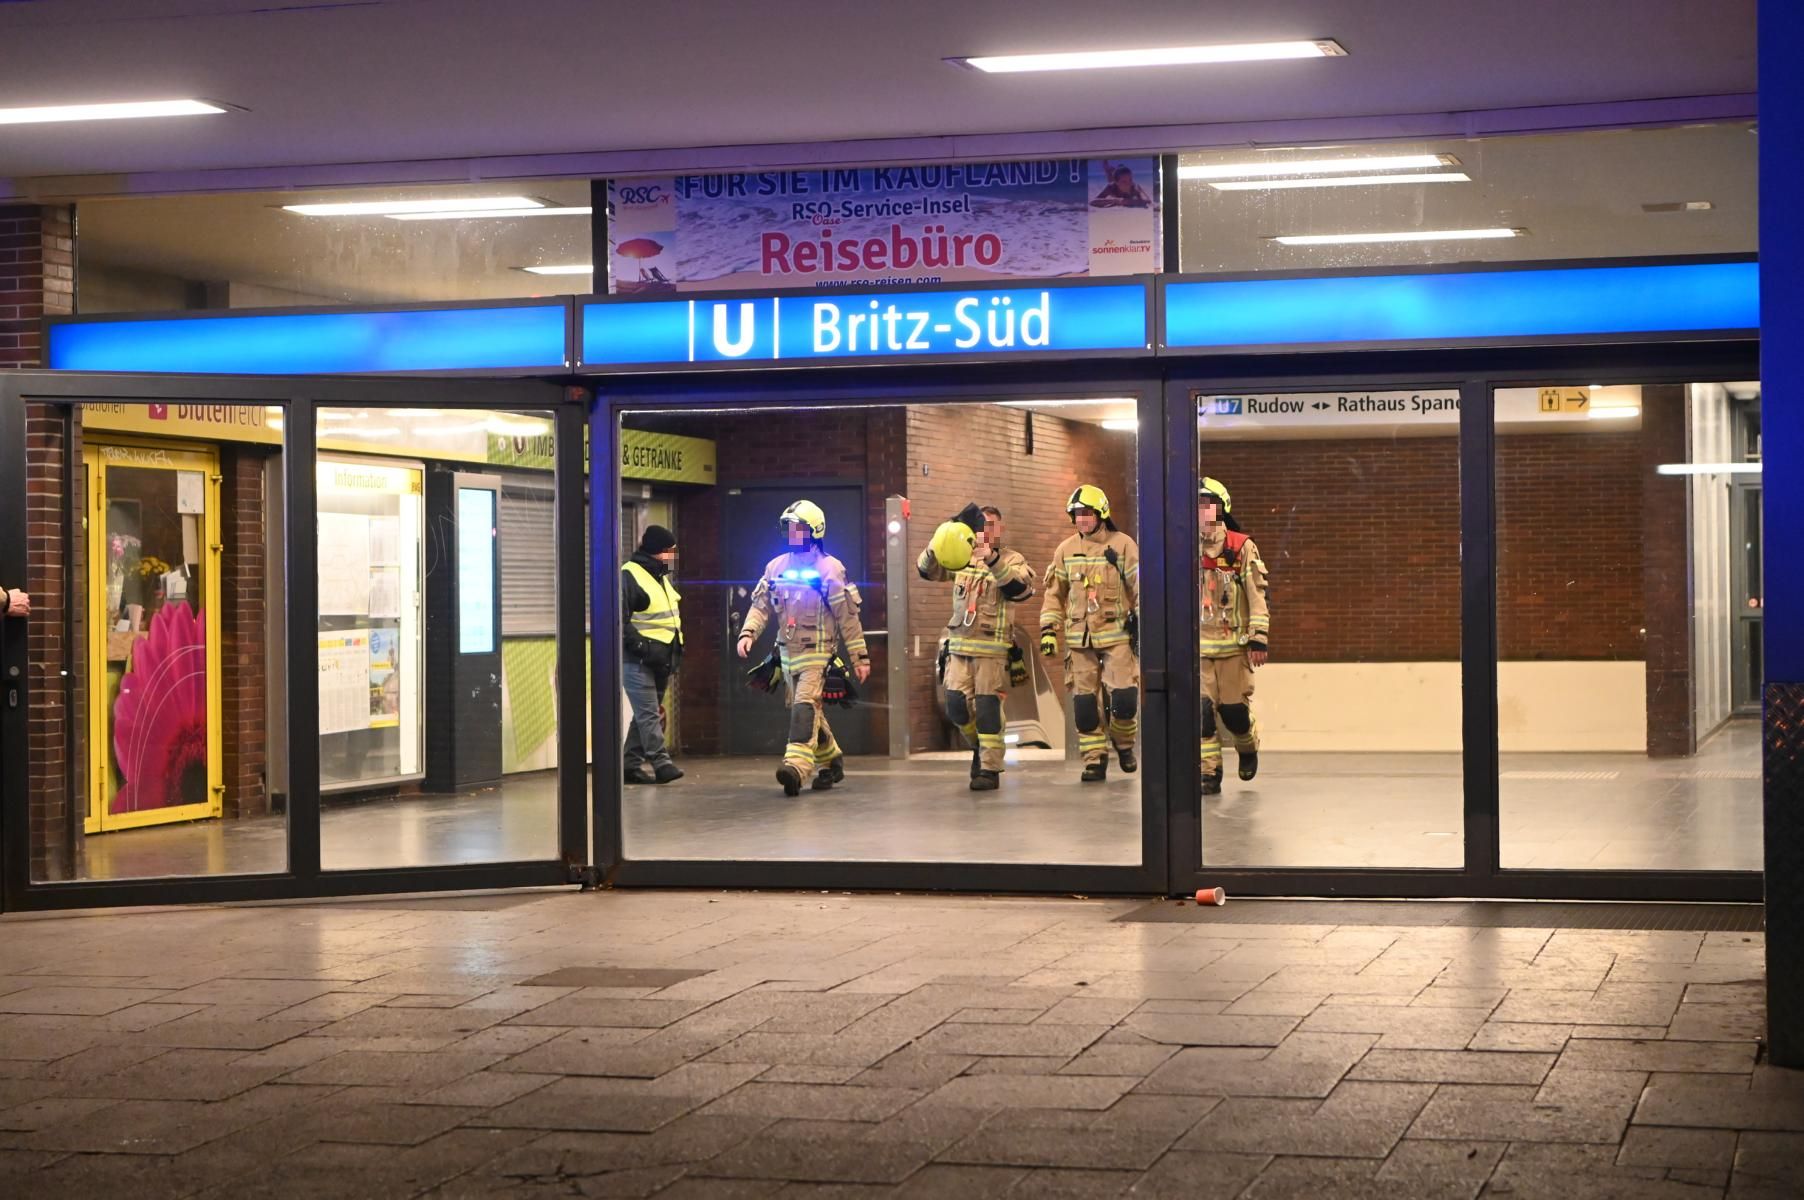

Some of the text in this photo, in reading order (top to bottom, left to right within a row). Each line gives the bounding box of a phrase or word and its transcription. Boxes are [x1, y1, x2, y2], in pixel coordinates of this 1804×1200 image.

[758, 170, 809, 197] SIE
[822, 168, 859, 193] IM
[874, 160, 1058, 191] KAUFLAND
[761, 224, 1002, 274] Reisebüro
[713, 291, 1050, 357] U Britz-Süd
[1217, 399, 1240, 413] U7
[1247, 397, 1305, 413] Rudow
[1338, 395, 1406, 412] Rathaus
[533, 435, 555, 457] IMB
[622, 444, 630, 465] &
[633, 444, 683, 471] GETRÄNKE
[335, 470, 388, 489] Information
